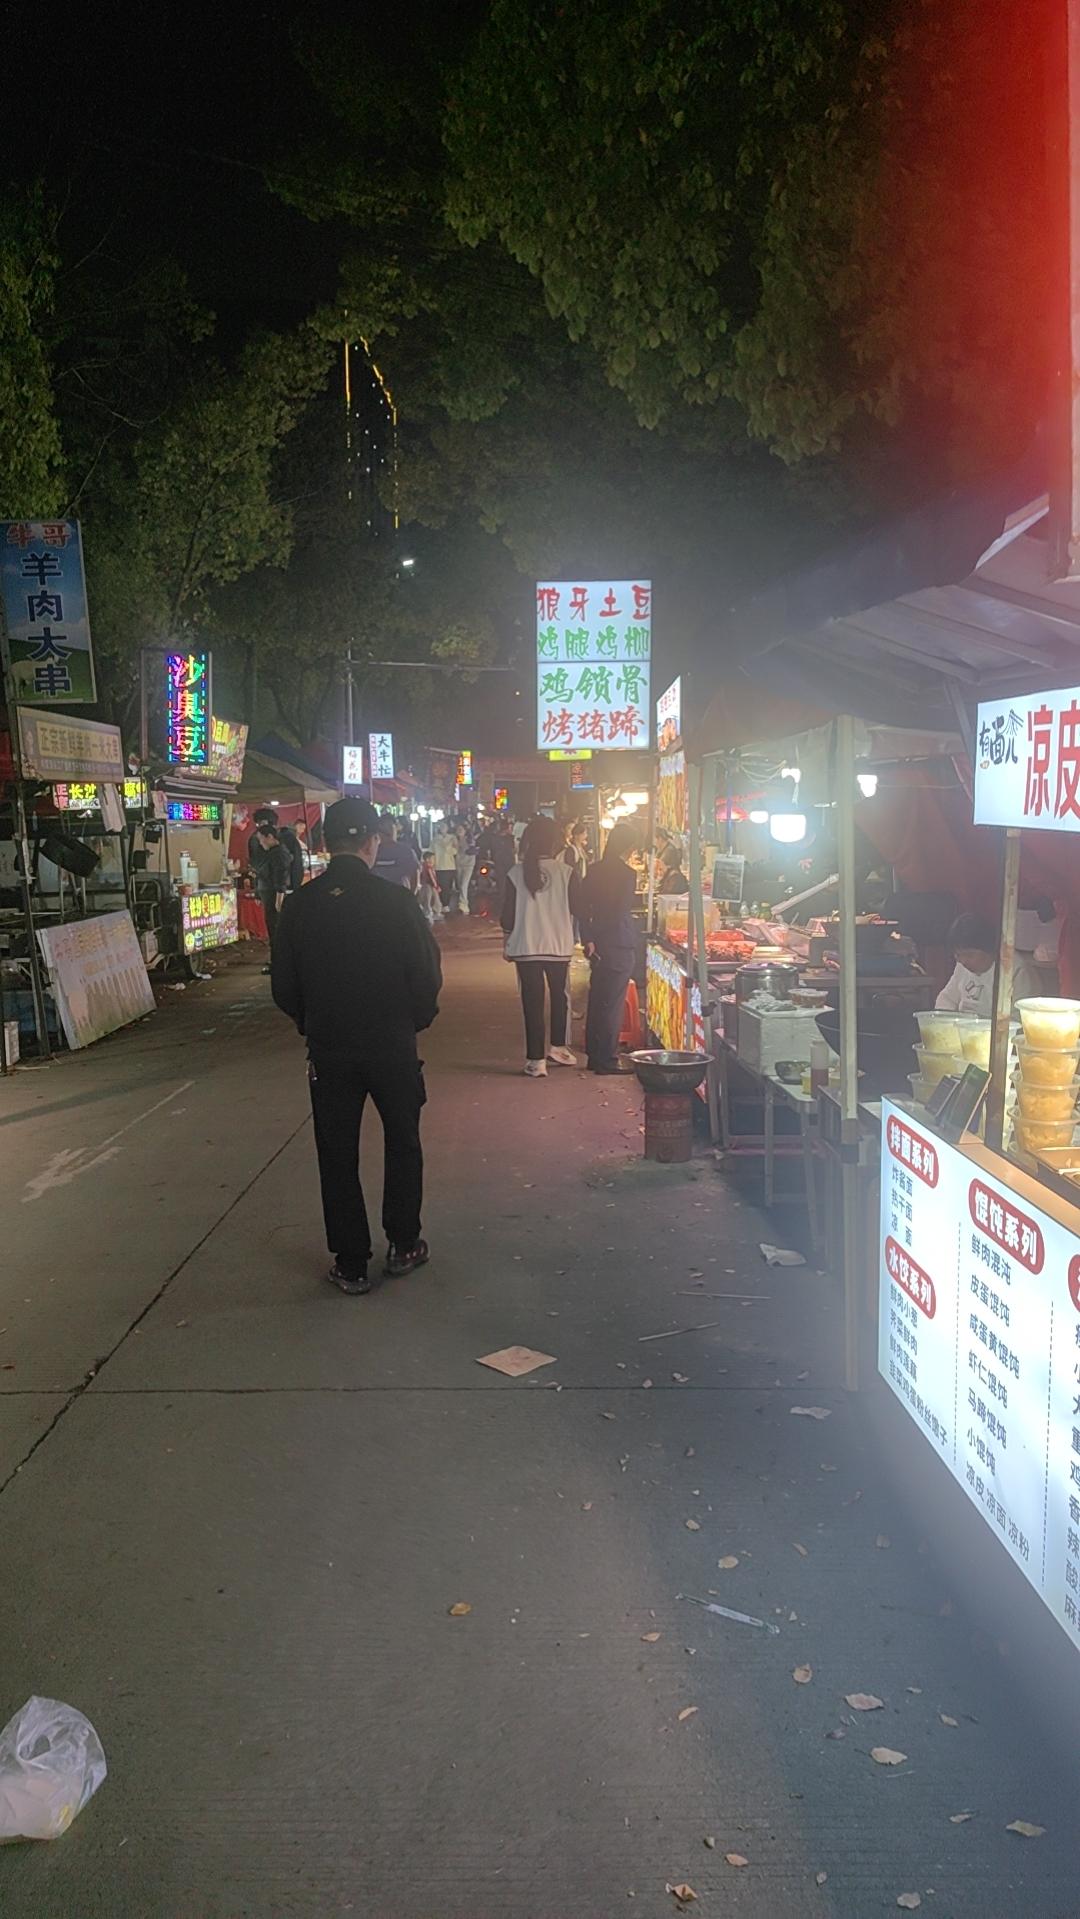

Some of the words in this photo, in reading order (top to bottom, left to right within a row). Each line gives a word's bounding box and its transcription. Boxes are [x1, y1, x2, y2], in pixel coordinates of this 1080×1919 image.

[21, 552, 73, 697] 羊肉大串
[537, 584, 651, 621] 狼牙土豆
[538, 625, 649, 660] 鸡腿鸡柳
[540, 664, 648, 704] 鸡锁骨
[542, 705, 645, 746] 烤猪蹄
[889, 1120, 935, 1182] 拌面系列
[891, 1188, 913, 1222] 热干面
[974, 1187, 1038, 1266] 馄饨系列
[889, 1246, 932, 1312] 水饺系列
[970, 1274, 1010, 1328] 皮蛋馄饨
[969, 1313, 1020, 1380] 咸蛋黄馄饨
[968, 1350, 1008, 1409] 虾仁馄饨
[967, 1386, 1008, 1450] 马蹄馄饨
[967, 1427, 996, 1477] 小馄饨
[966, 1461, 985, 1502] 凉皮
[986, 1488, 1007, 1531] 凉面
[1008, 1523, 1030, 1561] 凉粉
